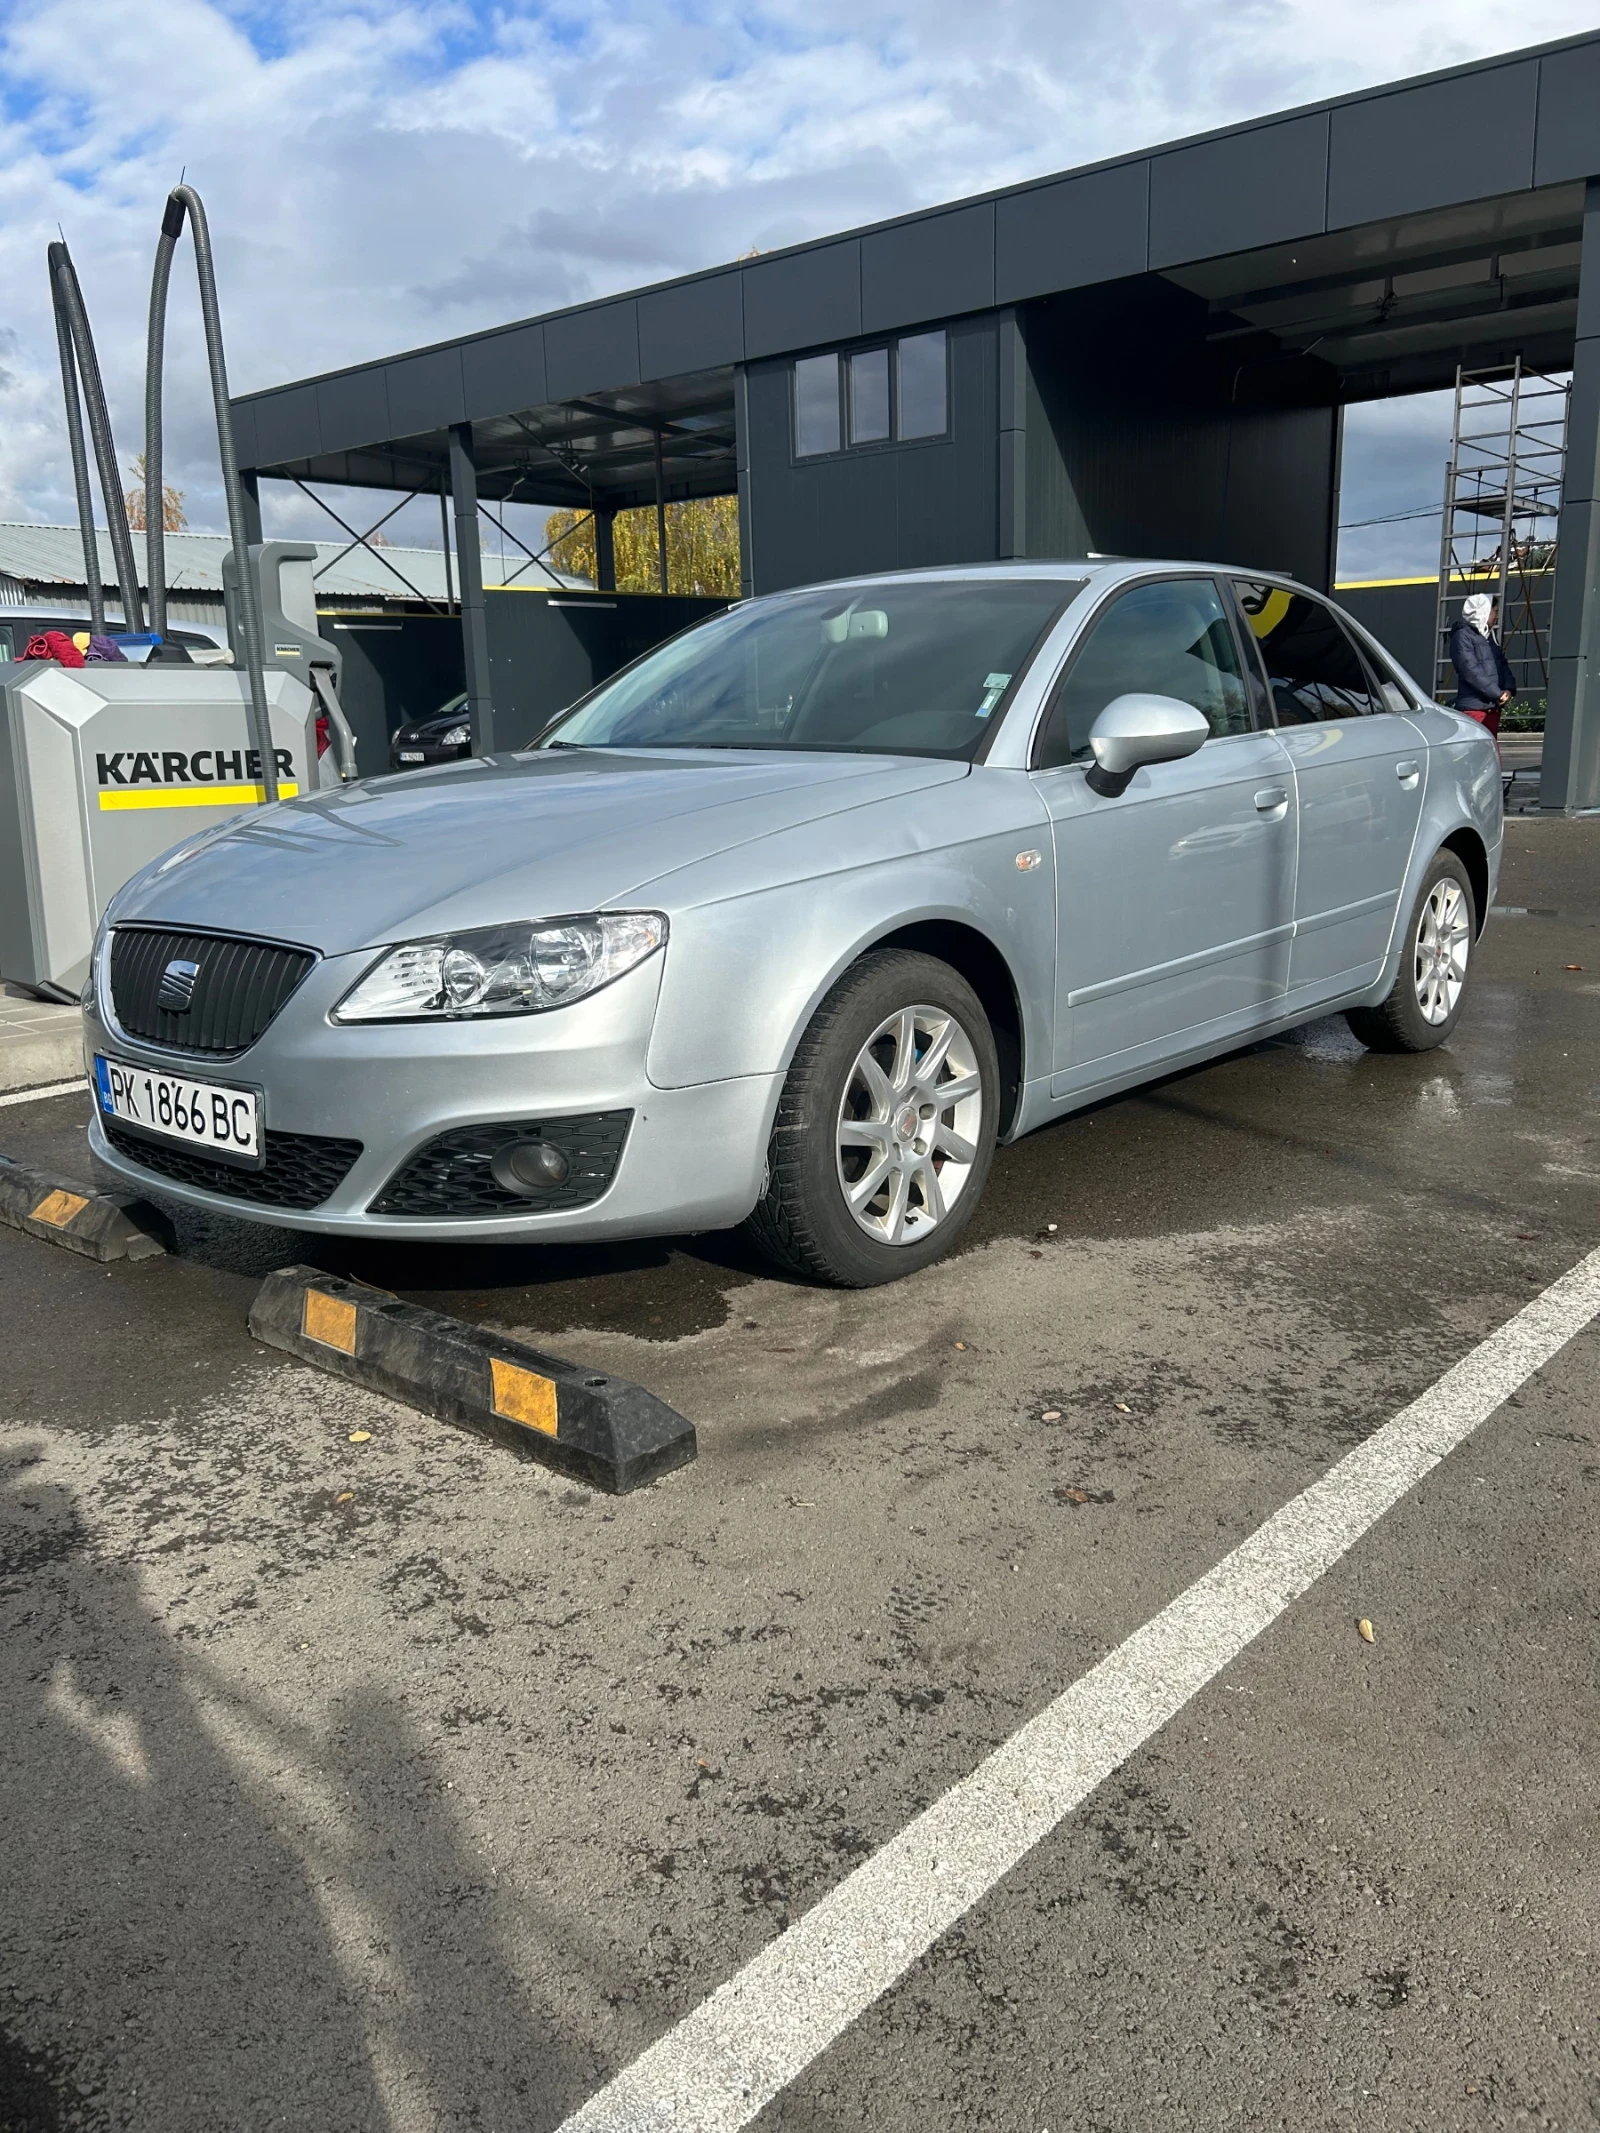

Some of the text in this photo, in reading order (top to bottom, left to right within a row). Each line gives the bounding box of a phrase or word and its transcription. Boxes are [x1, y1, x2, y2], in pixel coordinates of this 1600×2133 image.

[96, 749, 296, 785] KÄRCHER
[110, 1068, 251, 1146] PK 1866 BC
